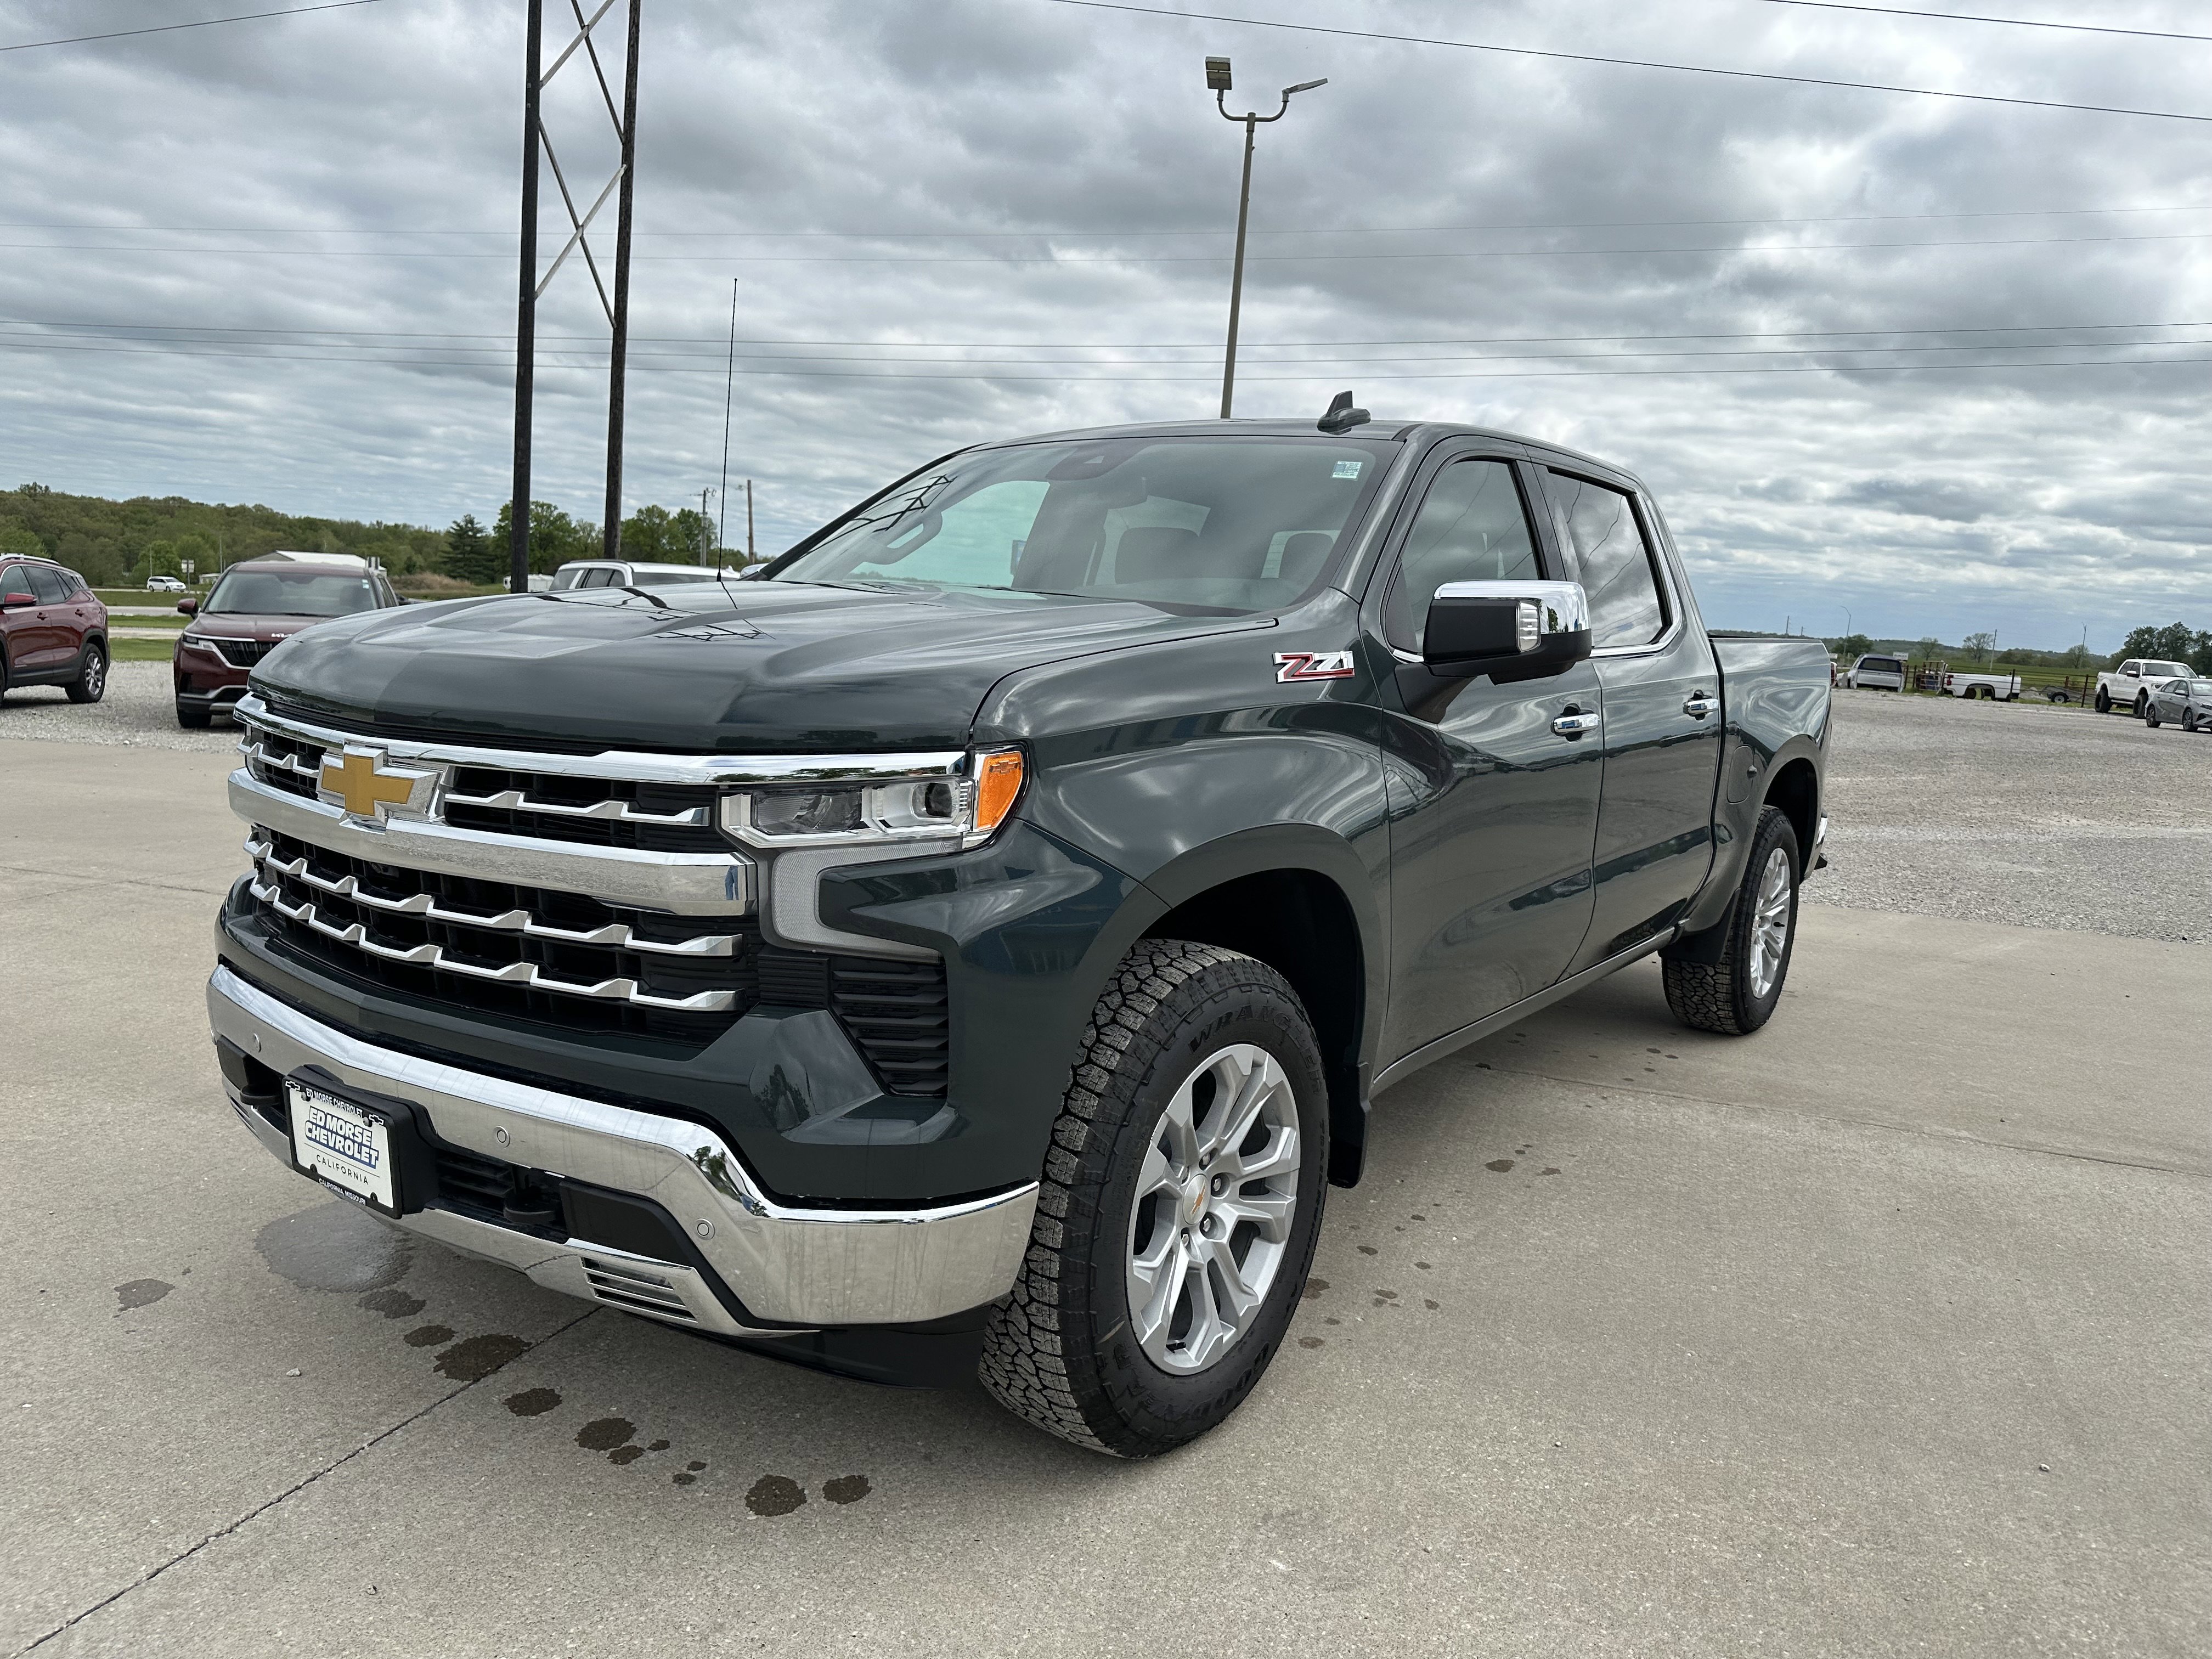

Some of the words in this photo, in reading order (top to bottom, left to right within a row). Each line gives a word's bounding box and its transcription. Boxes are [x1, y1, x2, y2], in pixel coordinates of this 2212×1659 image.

[1273, 651, 1355, 684] Z71
[306, 1087, 314, 1098] ED
[314, 1091, 333, 1106] MORSE
[333, 1098, 363, 1118] CHEVROLET
[309, 1105, 326, 1126] ED
[305, 1120, 379, 1169] CHEVROLET
[326, 1113, 372, 1148] MORSE
[317, 1154, 369, 1185] CALIFORNIA
[319, 1178, 345, 1196] CALIFORNIA,
[345, 1190, 366, 1205] MISSOURI
